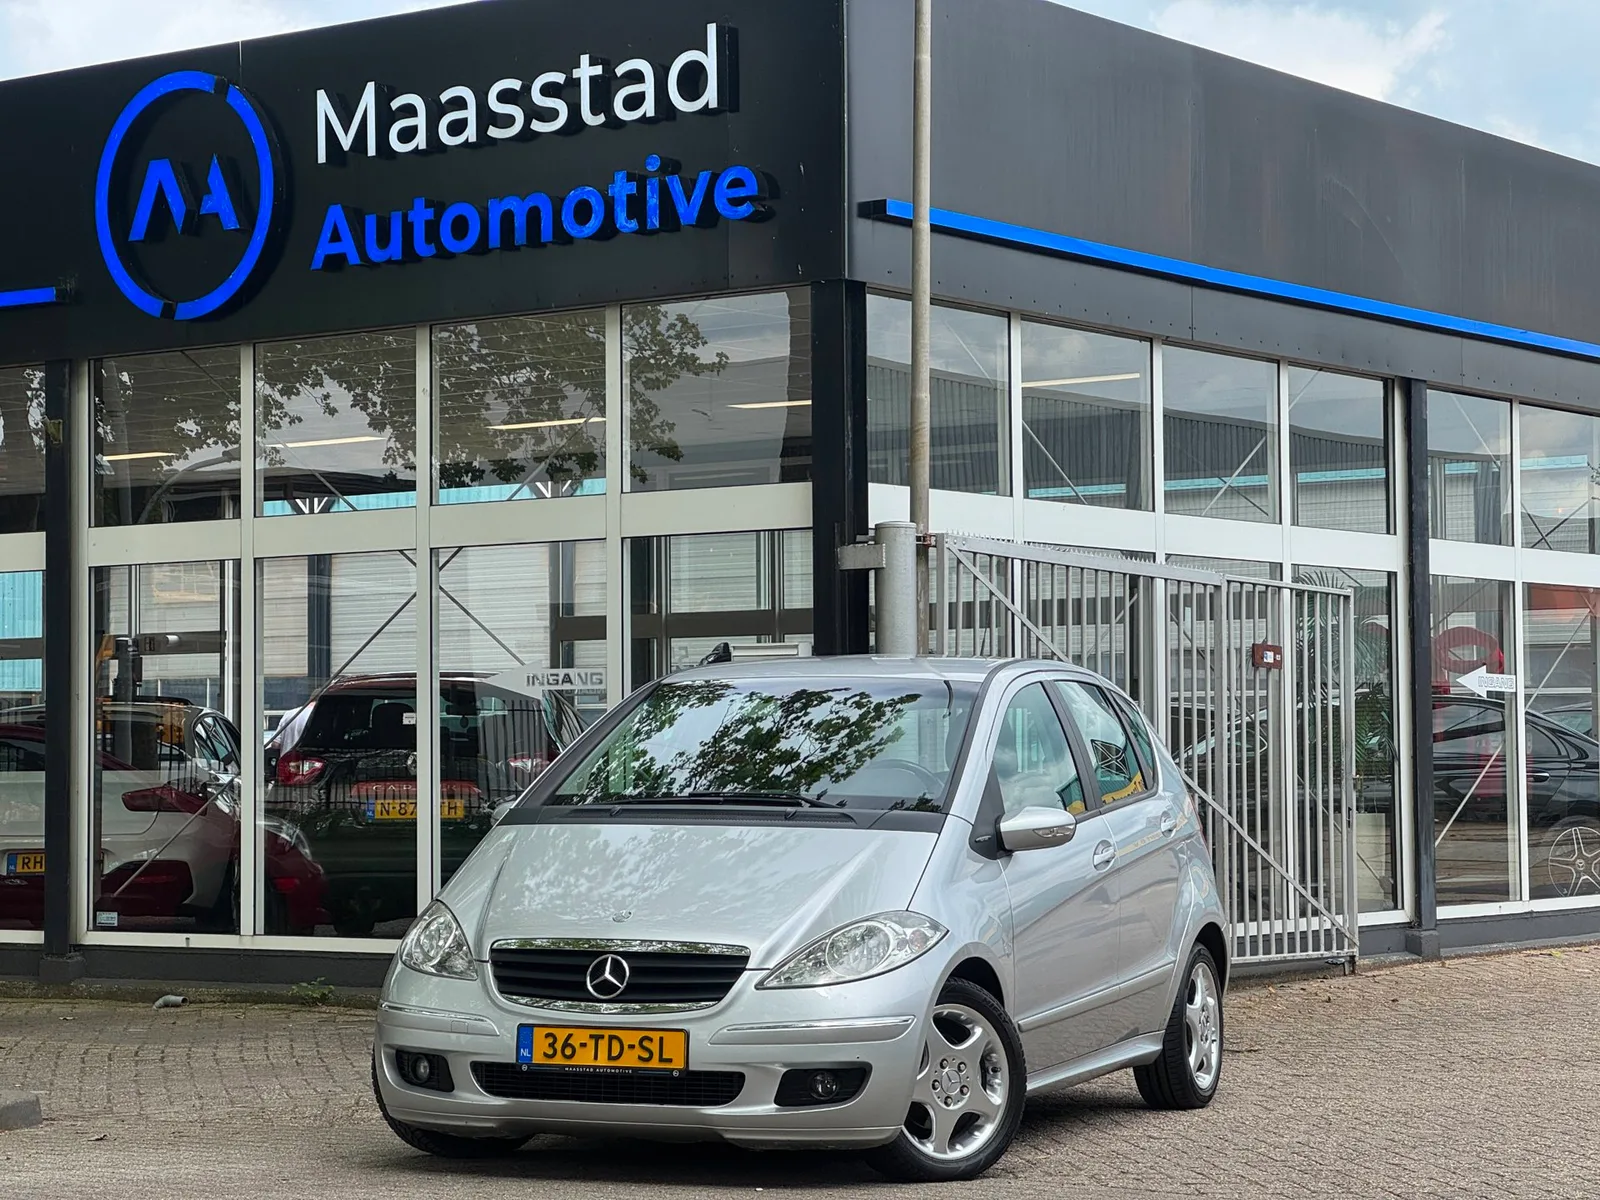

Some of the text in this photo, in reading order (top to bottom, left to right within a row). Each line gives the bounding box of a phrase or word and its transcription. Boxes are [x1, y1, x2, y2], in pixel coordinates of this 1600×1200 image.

[316, 22, 718, 164] Maasstad
[311, 154, 759, 270] Automotive
[526, 672, 604, 687] INGANG
[1477, 675, 1514, 690] INGANG
[520, 1032, 673, 1063] NL 36-TD-SL
